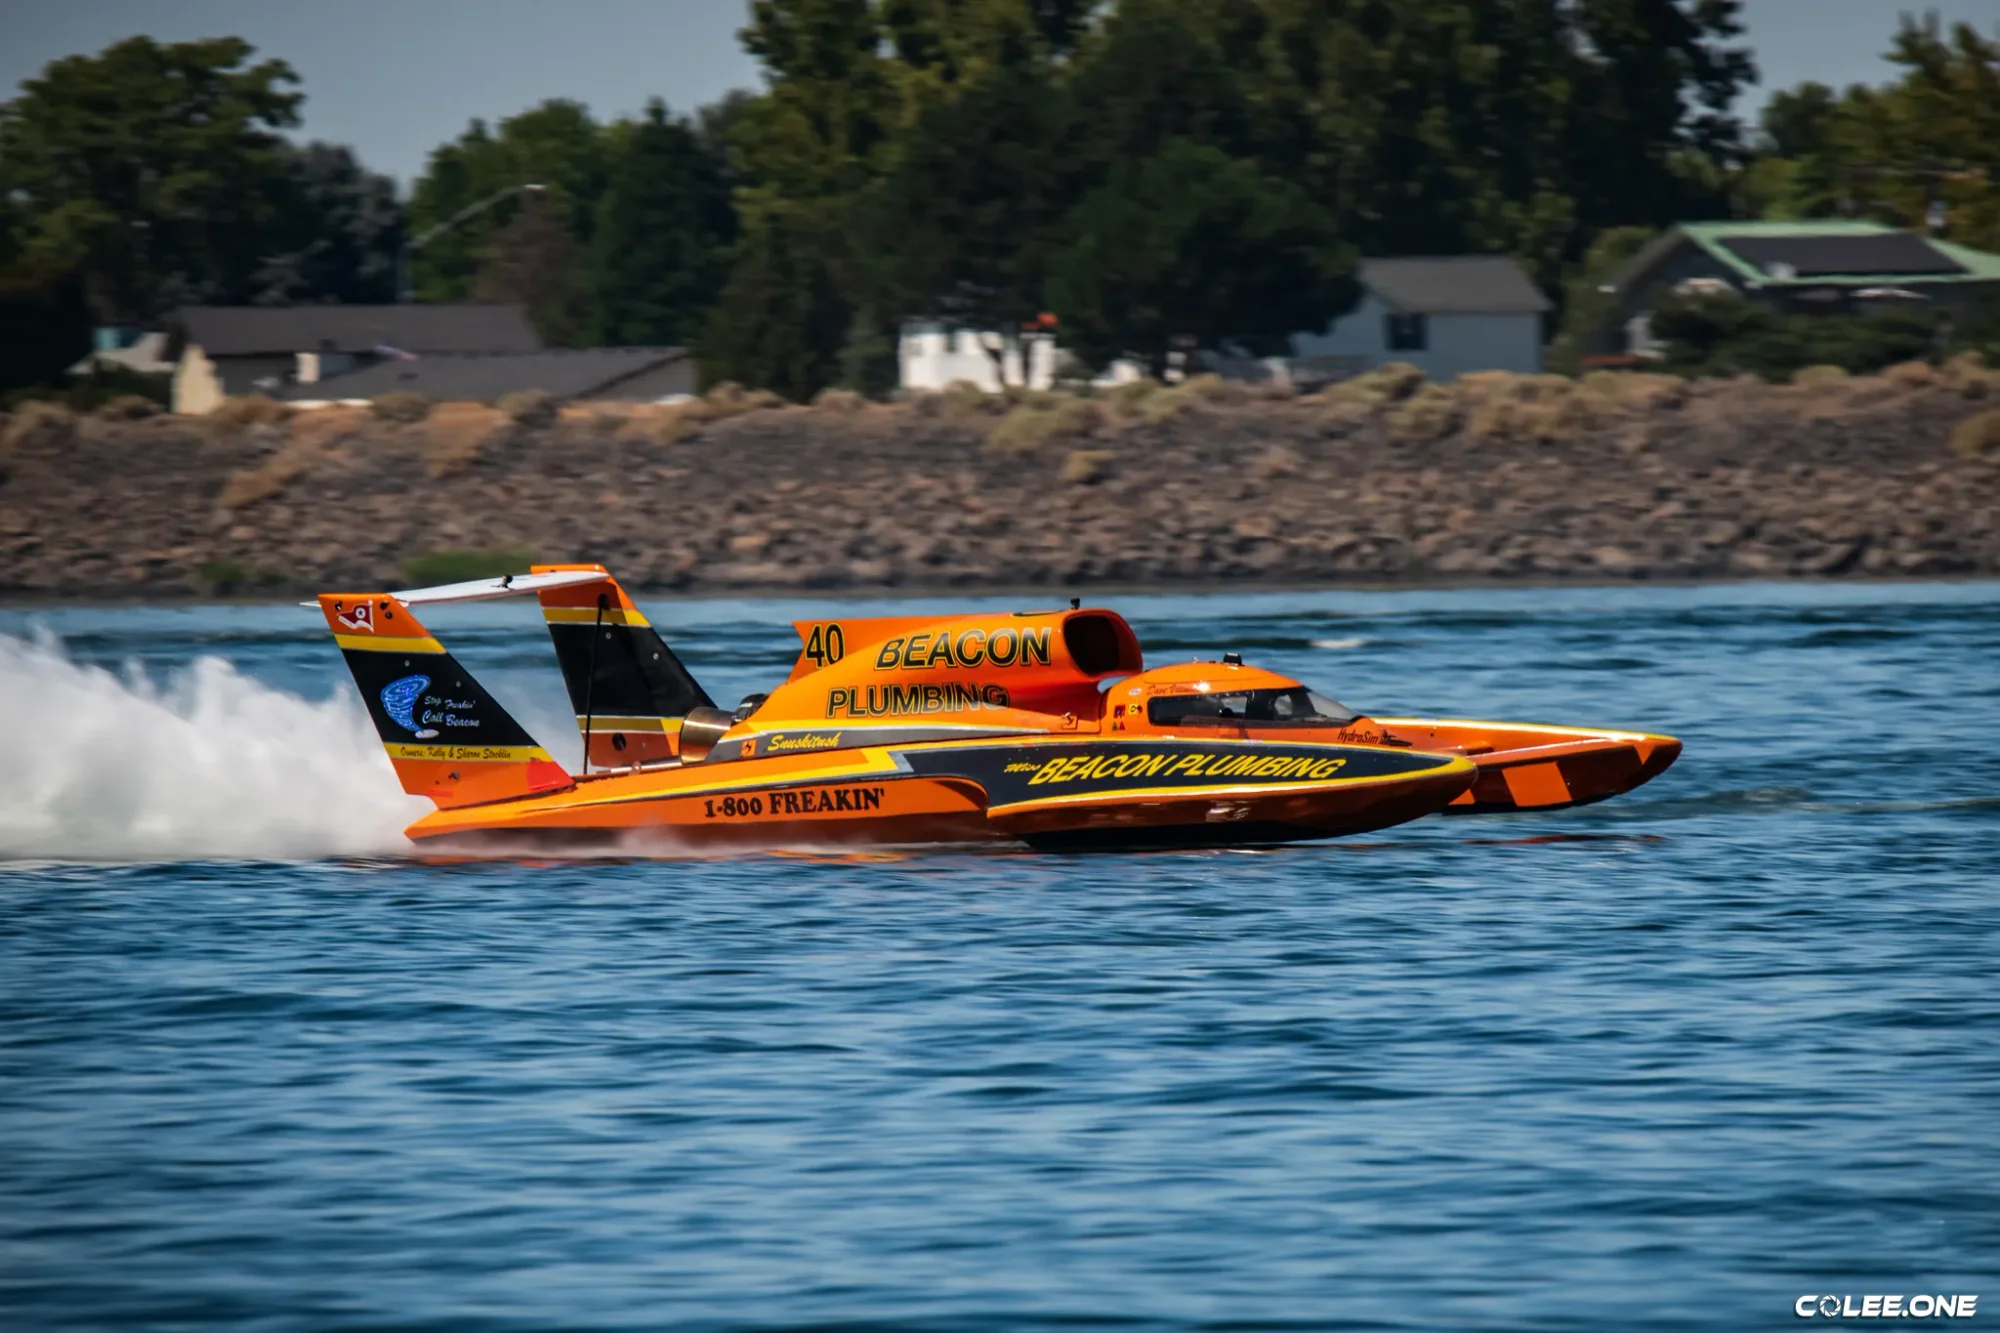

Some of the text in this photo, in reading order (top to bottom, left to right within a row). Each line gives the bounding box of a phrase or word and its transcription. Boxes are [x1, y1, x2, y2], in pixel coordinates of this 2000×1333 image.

[806, 622, 845, 670] 40
[874, 627, 1052, 670] BEACON
[424, 695, 441, 706] Stop
[826, 683, 1010, 718] PLUMBING
[422, 709, 480, 727] Call Beacon
[1337, 727, 1379, 744] HydroSim
[1027, 754, 1180, 785] BEACON
[1162, 754, 1347, 779] PLUMBING
[704, 788, 885, 818] 1-800 FREAKIN'
